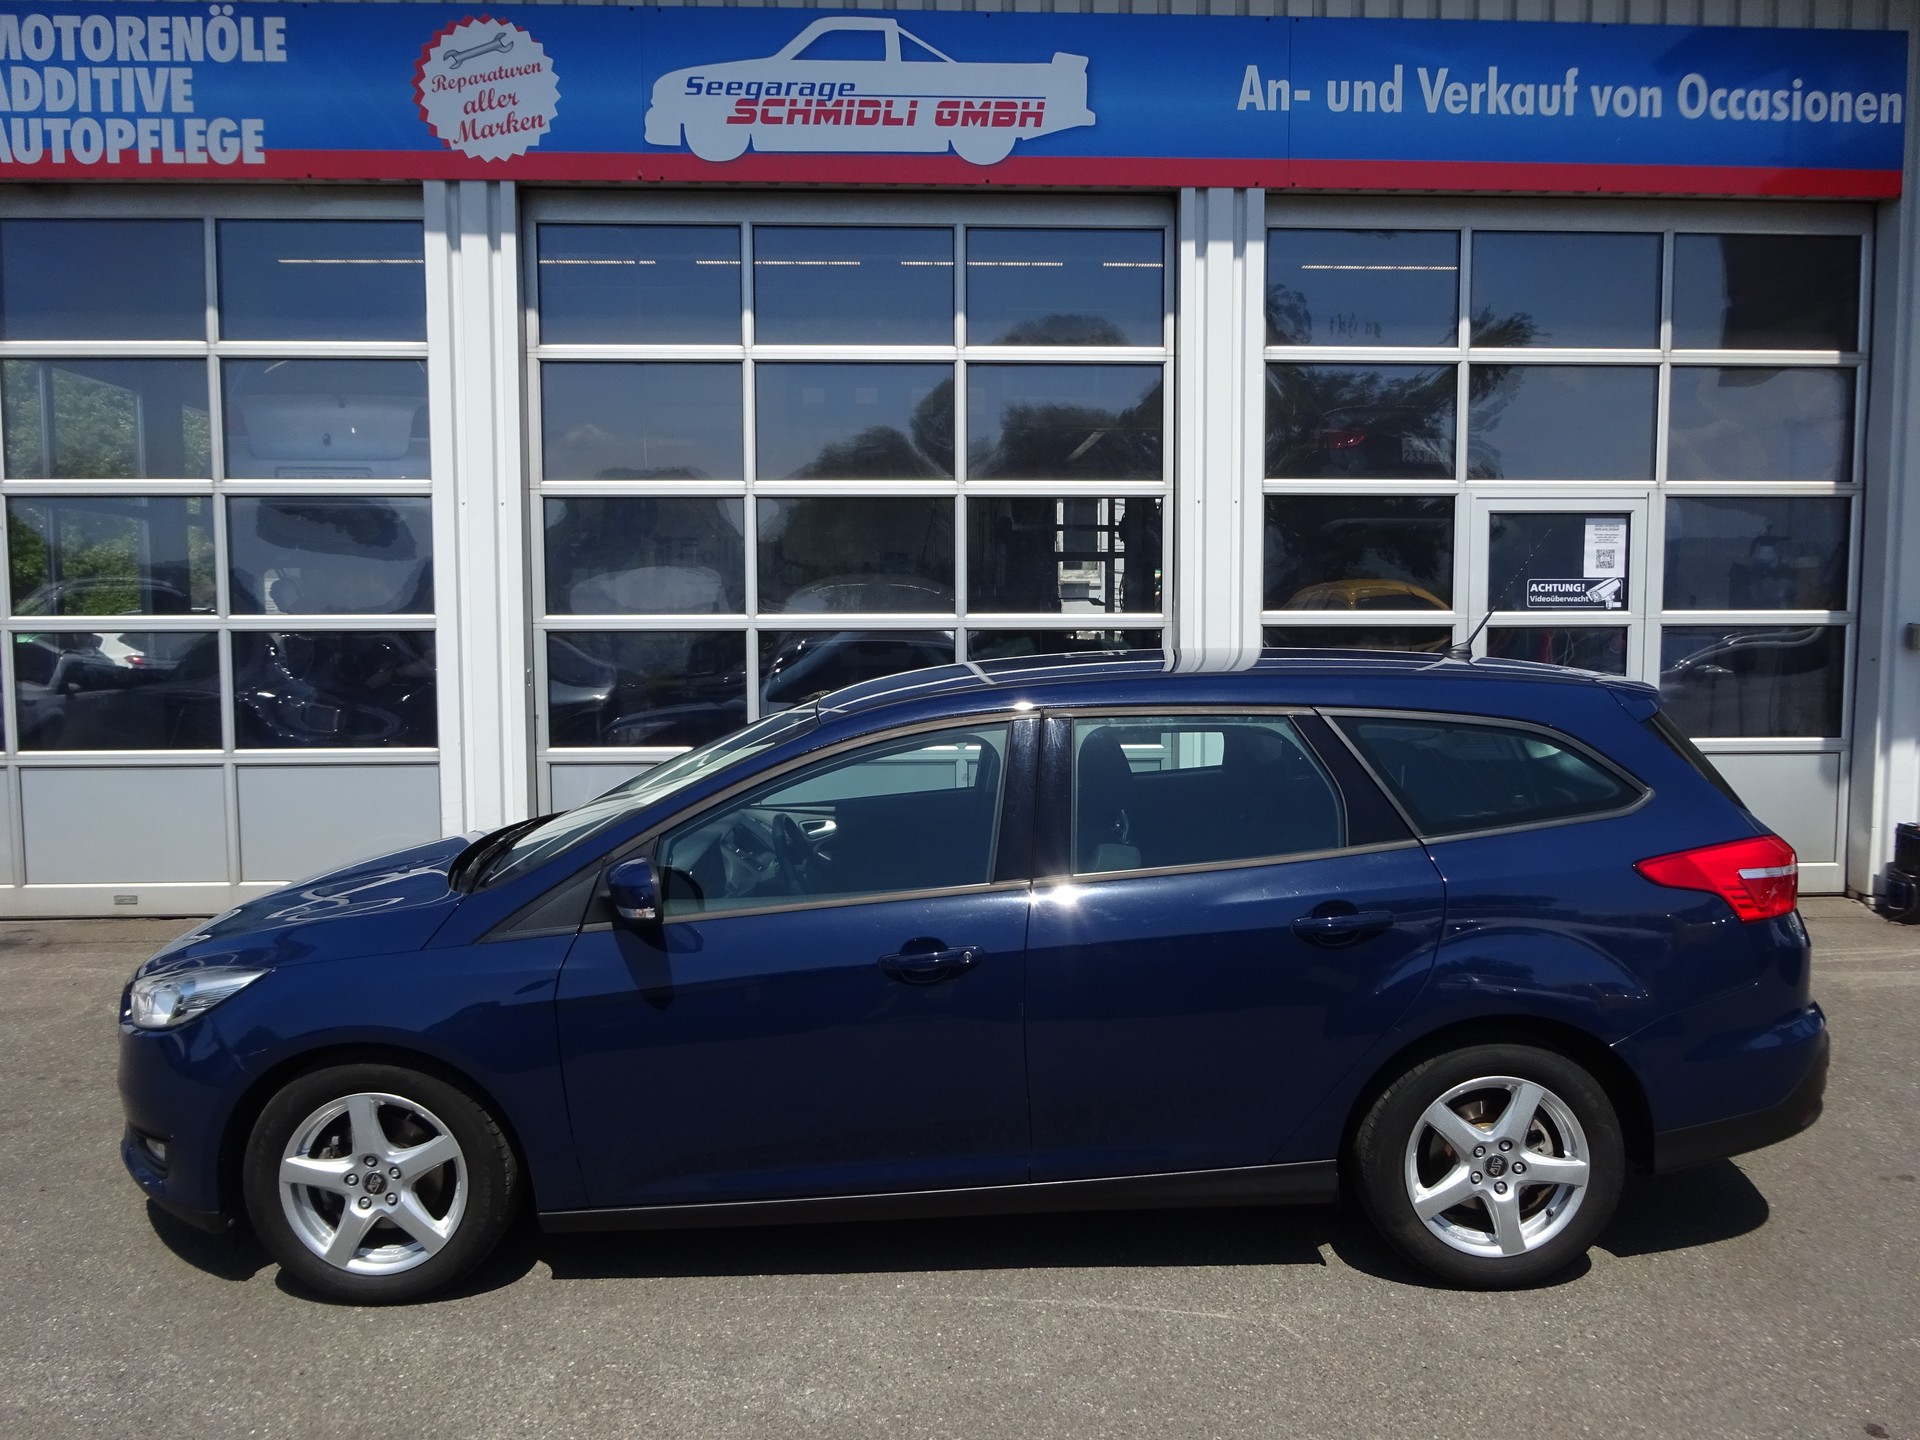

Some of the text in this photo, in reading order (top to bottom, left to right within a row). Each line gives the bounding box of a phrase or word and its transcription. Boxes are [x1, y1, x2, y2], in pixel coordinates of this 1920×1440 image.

[431, 62, 543, 93] Reparaturen
[685, 76, 856, 101] Seegarage
[463, 87, 520, 115] aller
[1237, 64, 1903, 124] An- und Verkauf von Occasionen
[452, 111, 546, 145] Marken
[726, 98, 1046, 128] SCHMIDLI GMBH
[1530, 583, 1585, 593] ACHTUNG!
